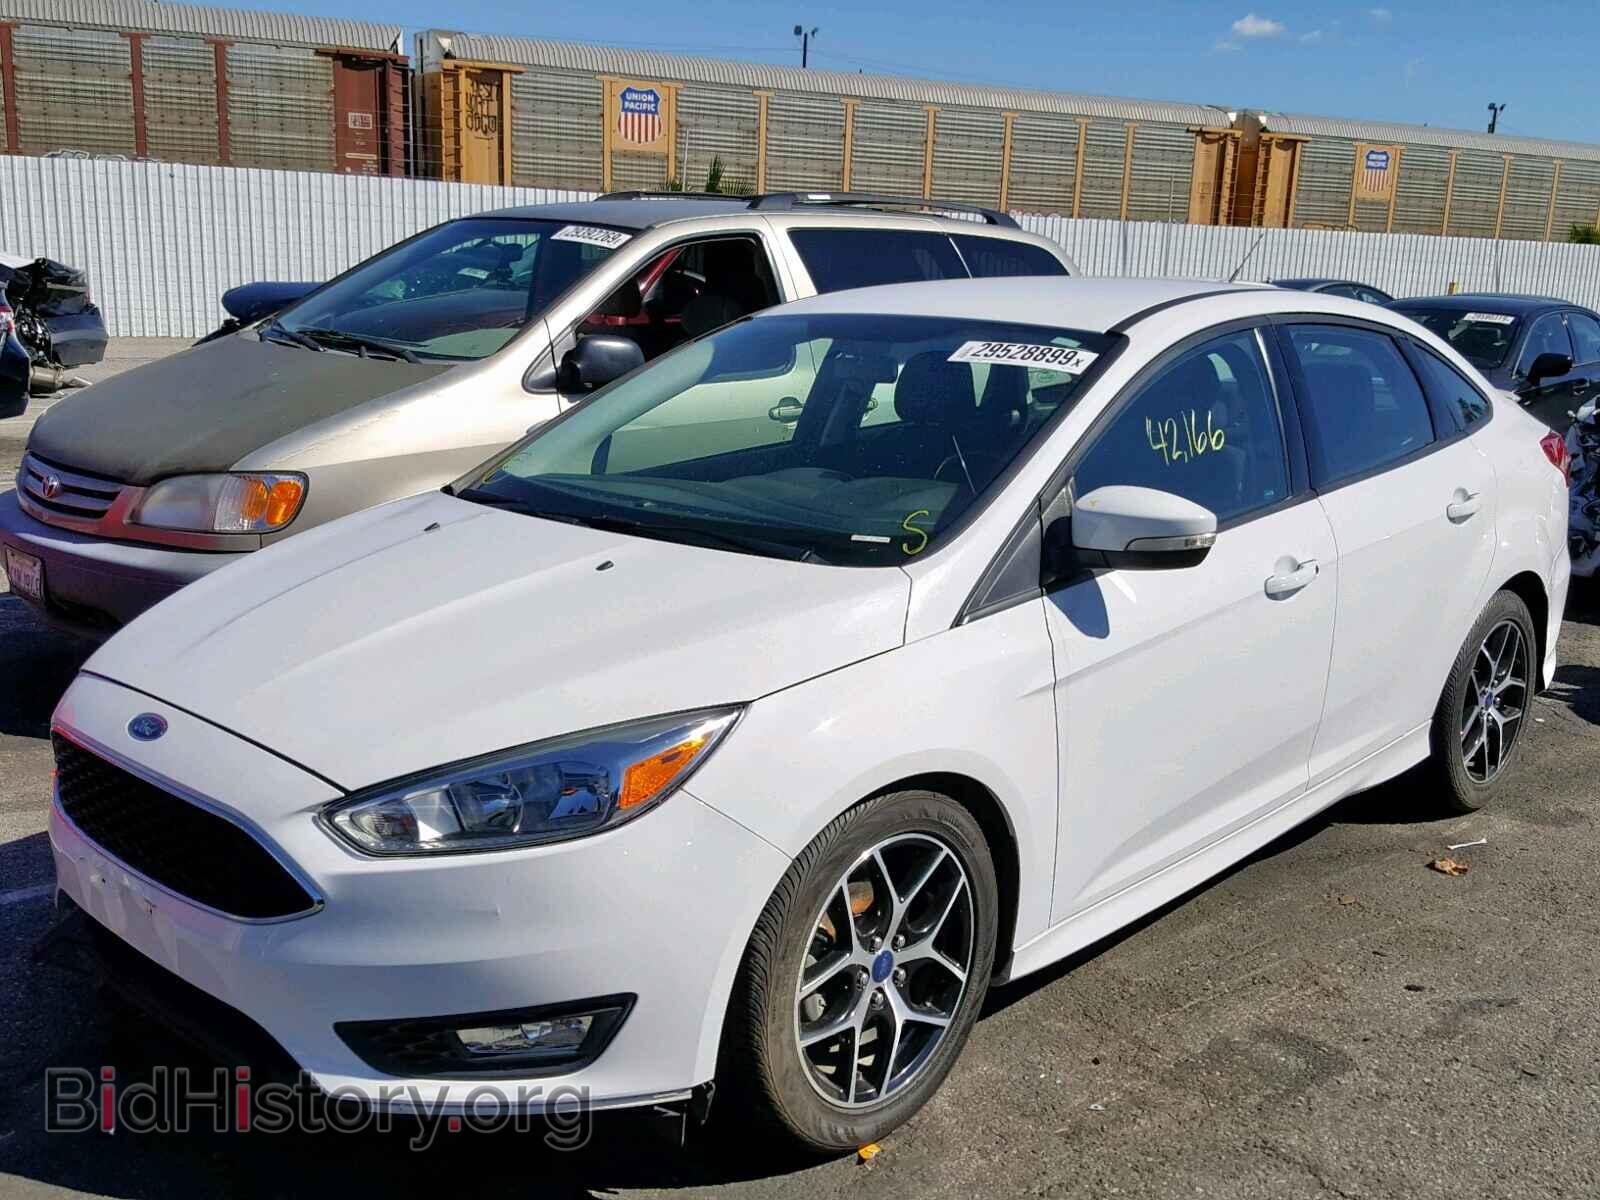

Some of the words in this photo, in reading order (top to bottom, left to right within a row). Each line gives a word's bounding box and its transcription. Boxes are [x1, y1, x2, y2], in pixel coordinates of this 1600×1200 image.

[625, 92, 655, 102] UNION
[624, 101, 656, 111] PACIFIC
[902, 510, 929, 555] S
